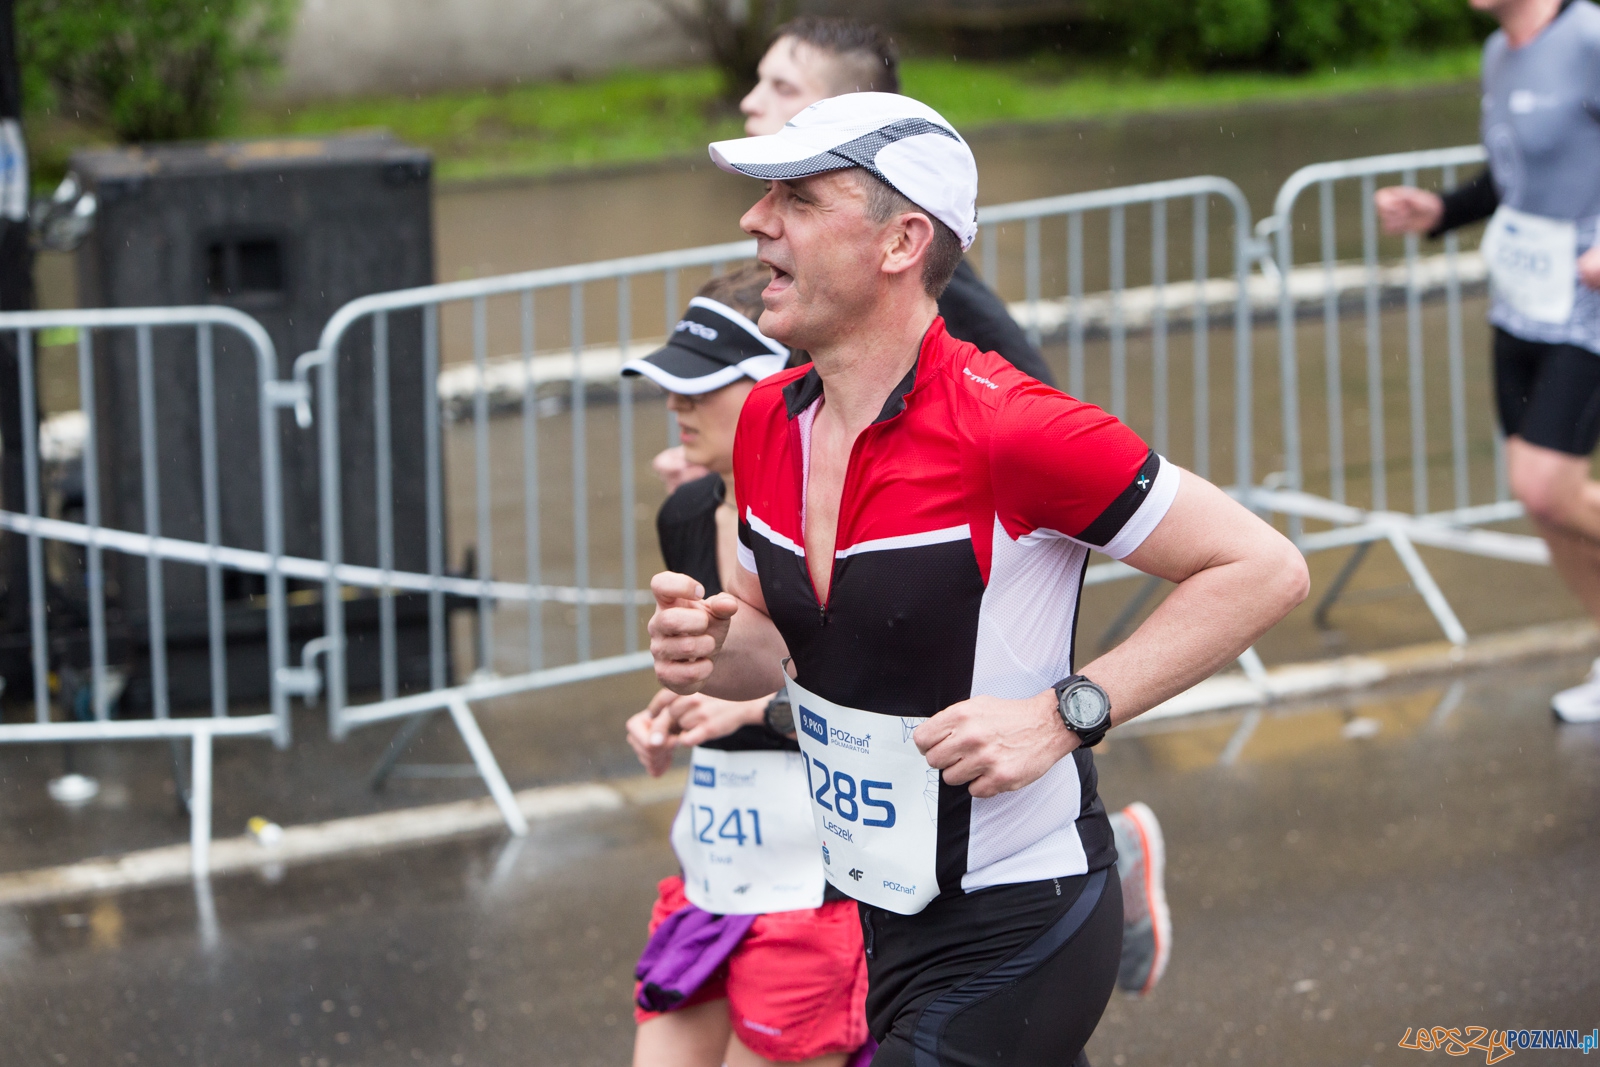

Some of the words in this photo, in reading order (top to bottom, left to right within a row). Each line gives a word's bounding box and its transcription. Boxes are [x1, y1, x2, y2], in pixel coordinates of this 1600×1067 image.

[802, 750, 896, 828] 1285
[690, 803, 763, 846] 1241
[822, 815, 854, 843] Leszek
[848, 867, 864, 881] 4F
